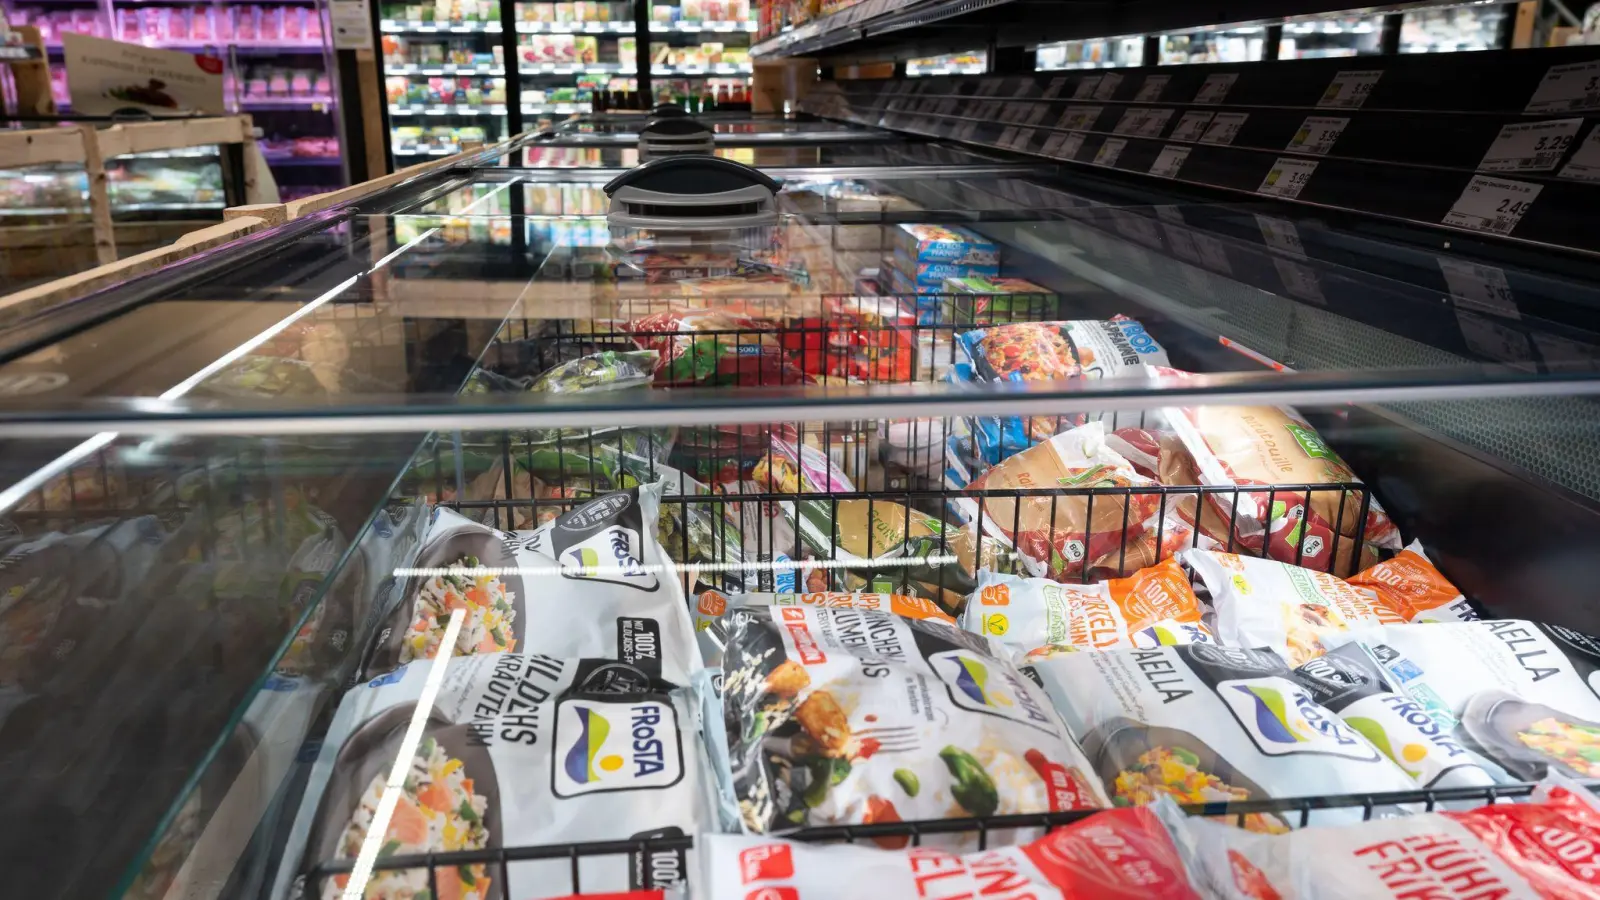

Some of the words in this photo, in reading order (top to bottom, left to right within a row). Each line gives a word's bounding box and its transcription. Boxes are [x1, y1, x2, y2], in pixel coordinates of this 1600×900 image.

[1534, 135, 1572, 150] 3.29
[1496, 199, 1532, 216] 2.49
[634, 631, 657, 660] 100%
[1481, 620, 1561, 683] AELLA
